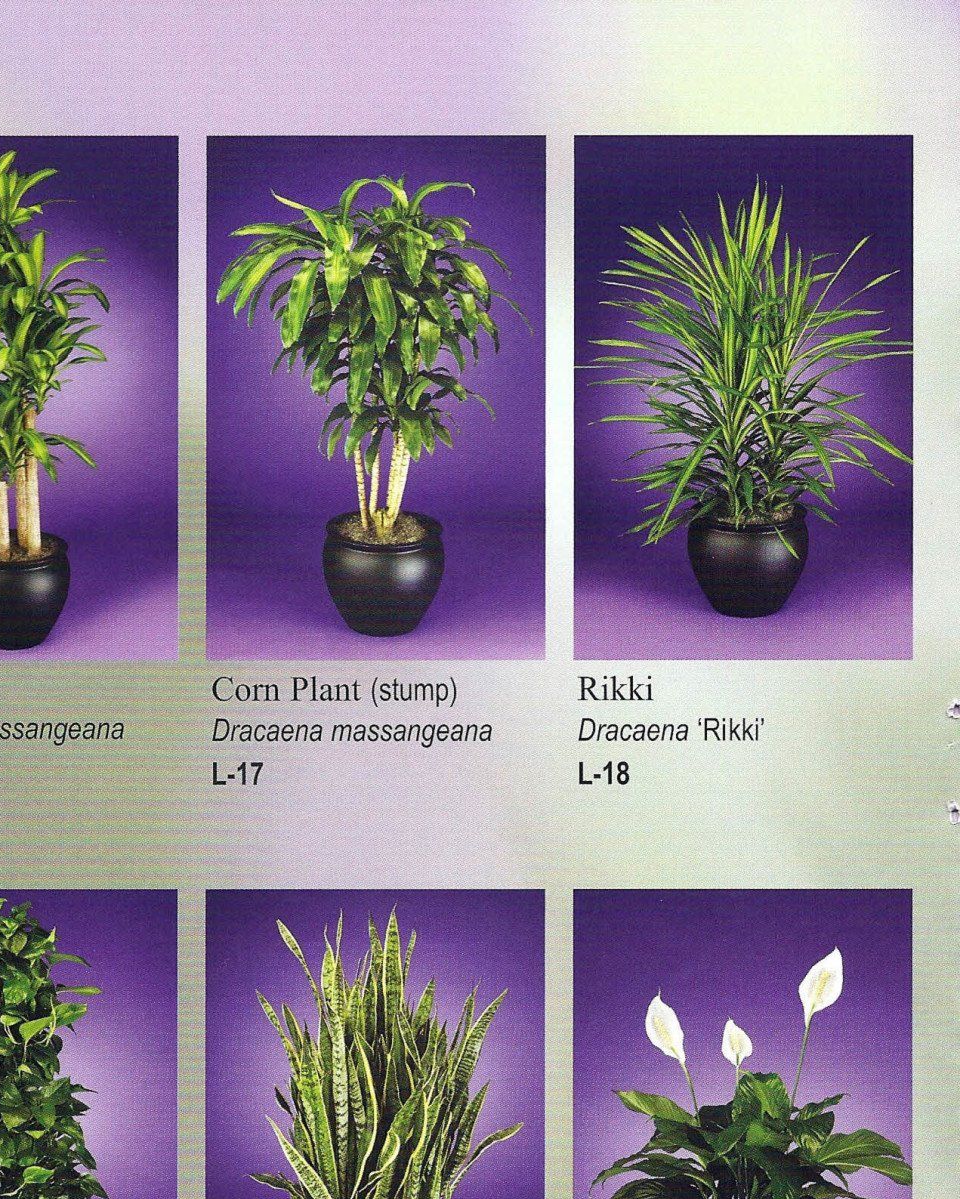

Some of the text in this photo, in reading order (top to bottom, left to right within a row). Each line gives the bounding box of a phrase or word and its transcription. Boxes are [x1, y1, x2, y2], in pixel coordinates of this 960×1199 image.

[211, 675, 457, 708] Corn Plant (stump)
[579, 675, 653, 701] Rikki
[211, 717, 493, 749] Dracaena massangeana
[578, 717, 765, 742] Dracaena ‘Rikki’
[212, 761, 264, 786] L-17
[578, 760, 630, 786] L-18
